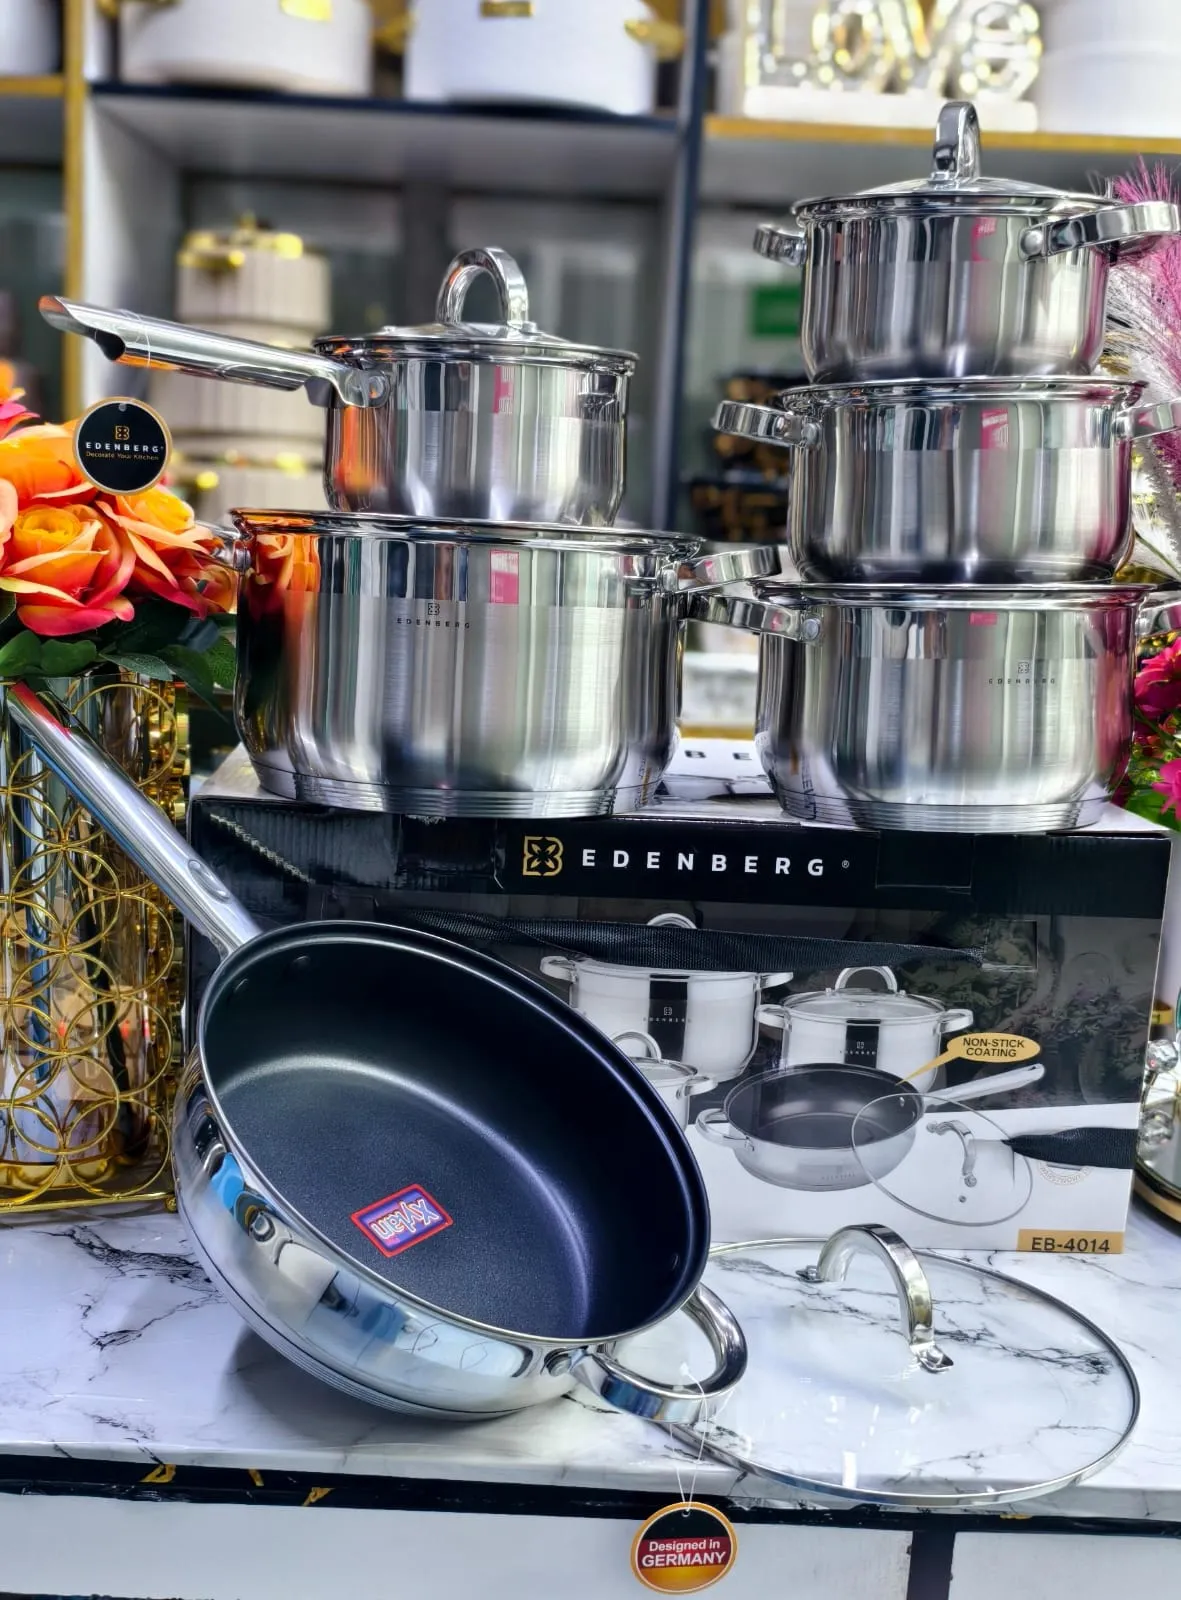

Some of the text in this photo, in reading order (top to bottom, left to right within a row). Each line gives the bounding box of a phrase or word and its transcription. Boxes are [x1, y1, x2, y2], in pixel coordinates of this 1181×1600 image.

[85, 442, 159, 453] EDENBERG
[397, 617, 470, 629] EDENBERG
[582, 848, 824, 876] EDENBERG
[963, 1037, 1025, 1049] NON-STICK
[966, 1047, 1017, 1057] COATING
[1031, 1236, 1110, 1253] EB-4014
[649, 1538, 720, 1553] Designed in
[642, 1551, 726, 1567] GERMANY
